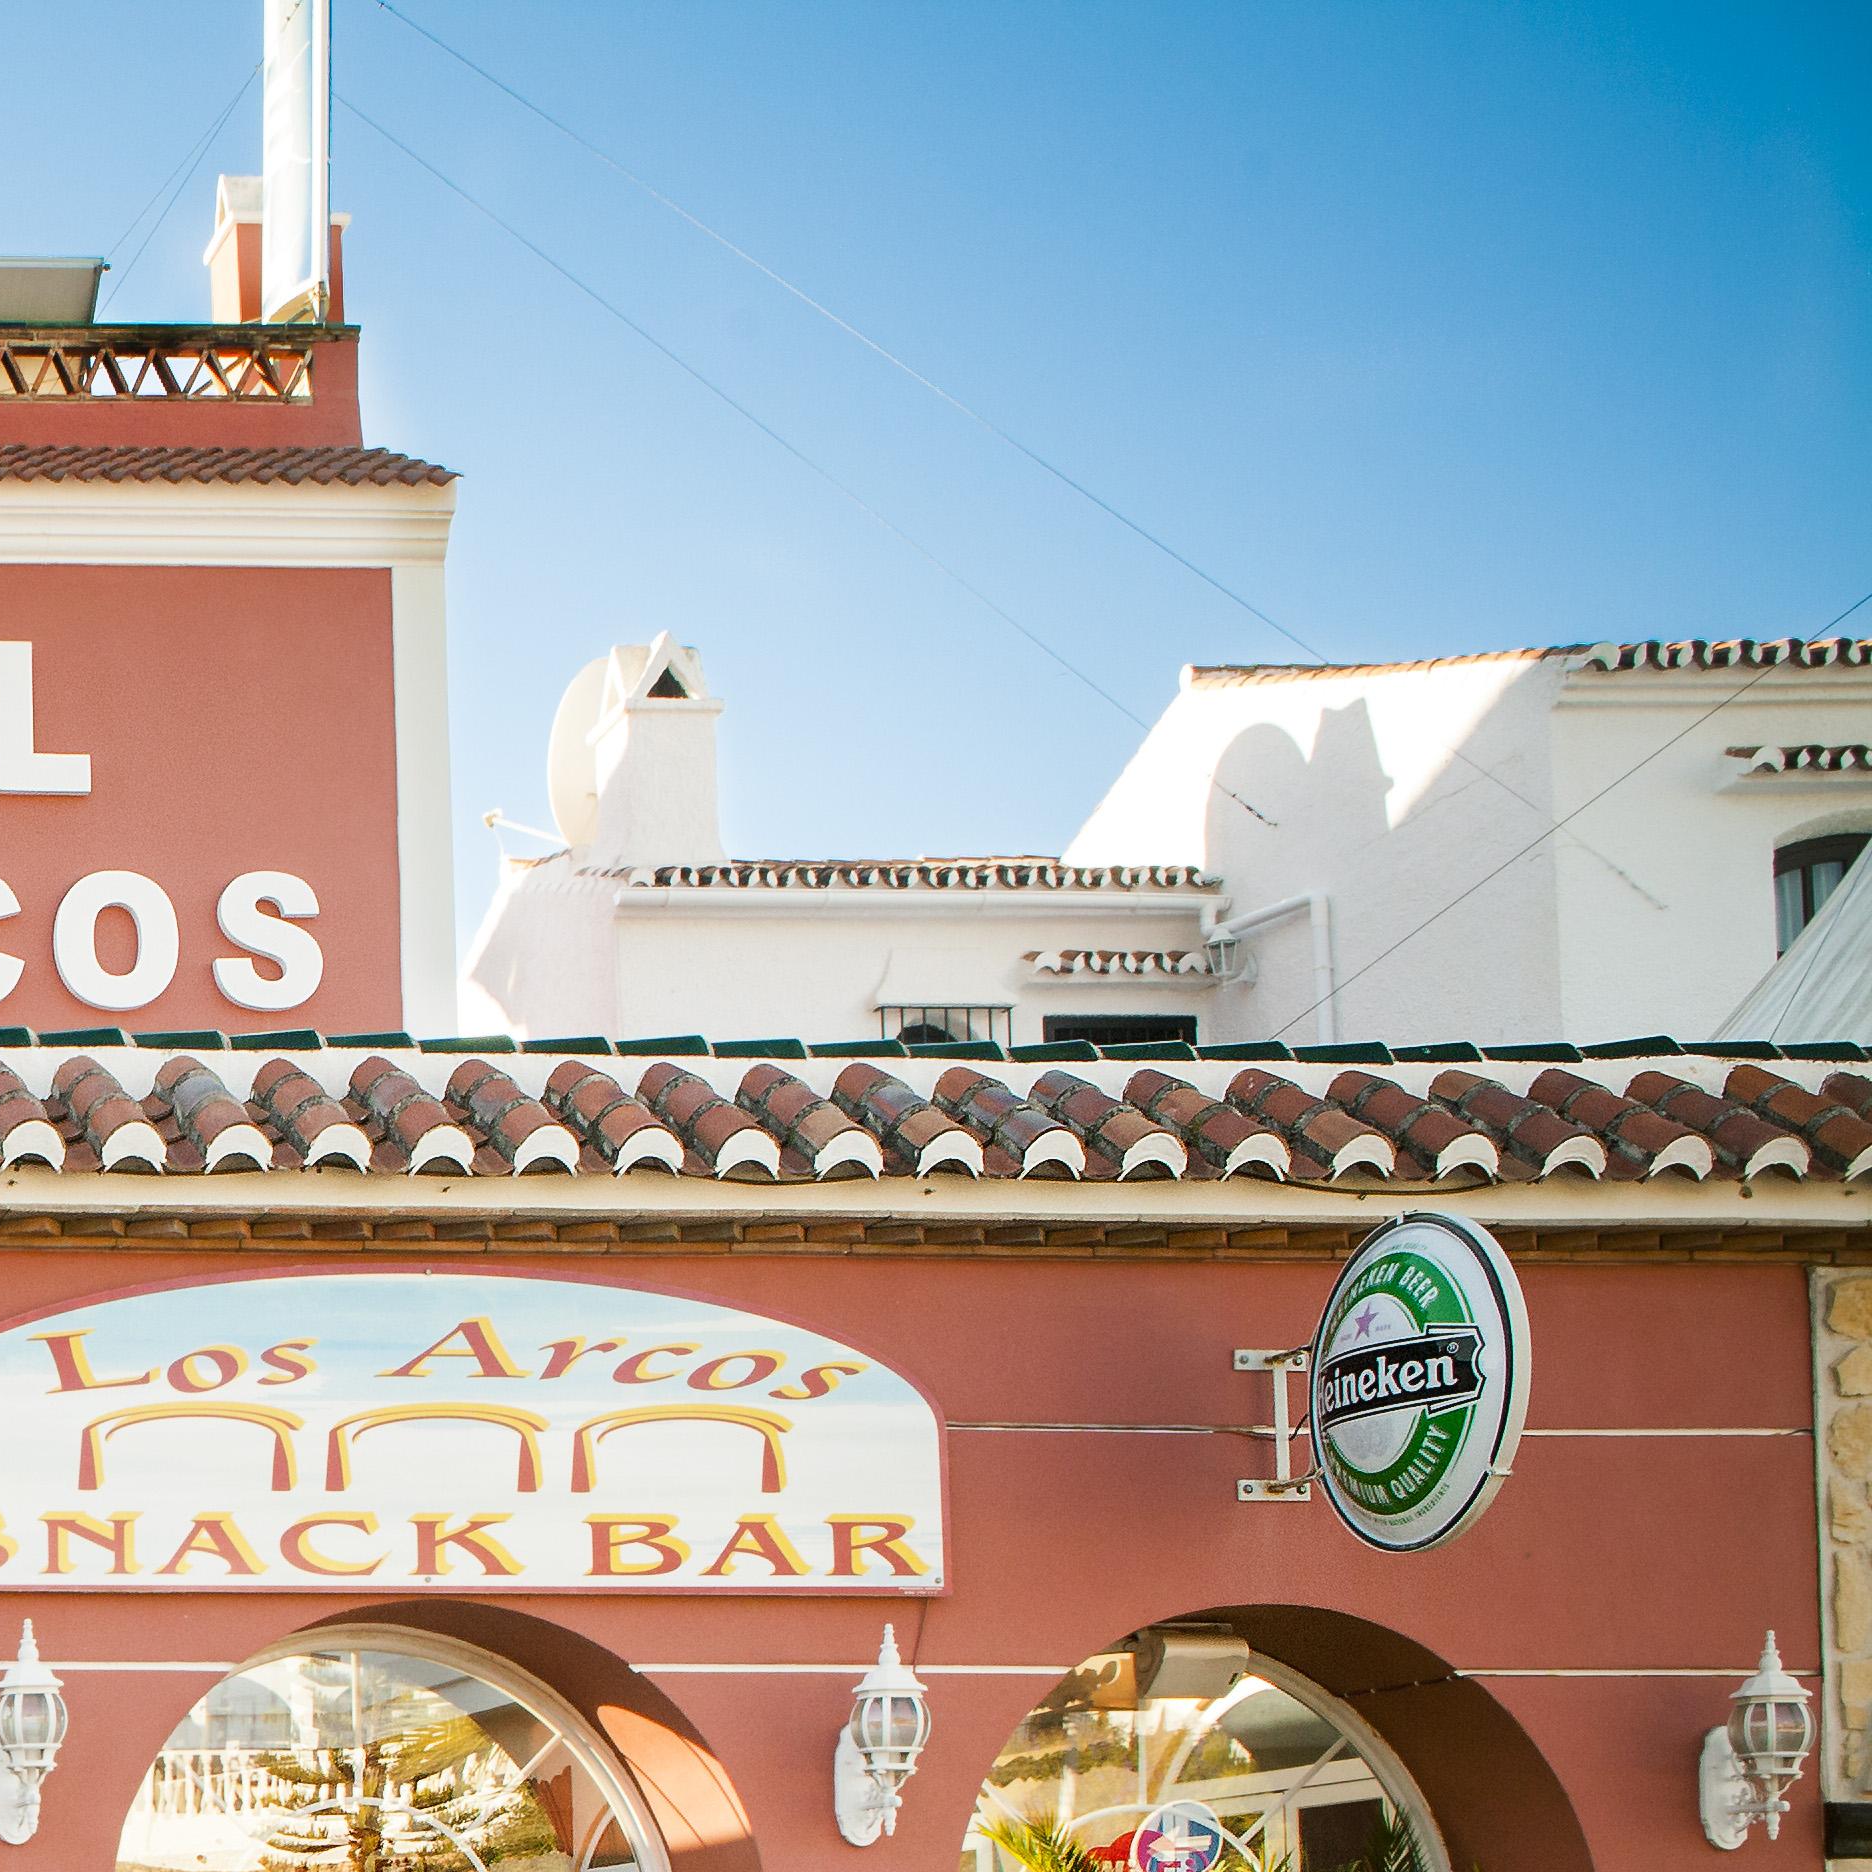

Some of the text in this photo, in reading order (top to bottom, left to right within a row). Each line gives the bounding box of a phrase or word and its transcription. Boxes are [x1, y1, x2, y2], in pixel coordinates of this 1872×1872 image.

[1399, 1265, 1439, 1310] BEER
[27, 1315, 871, 1402] Los Arcos
[1390, 1423, 1451, 1499] QUALITY
[582, 1512, 939, 1577] BAR
